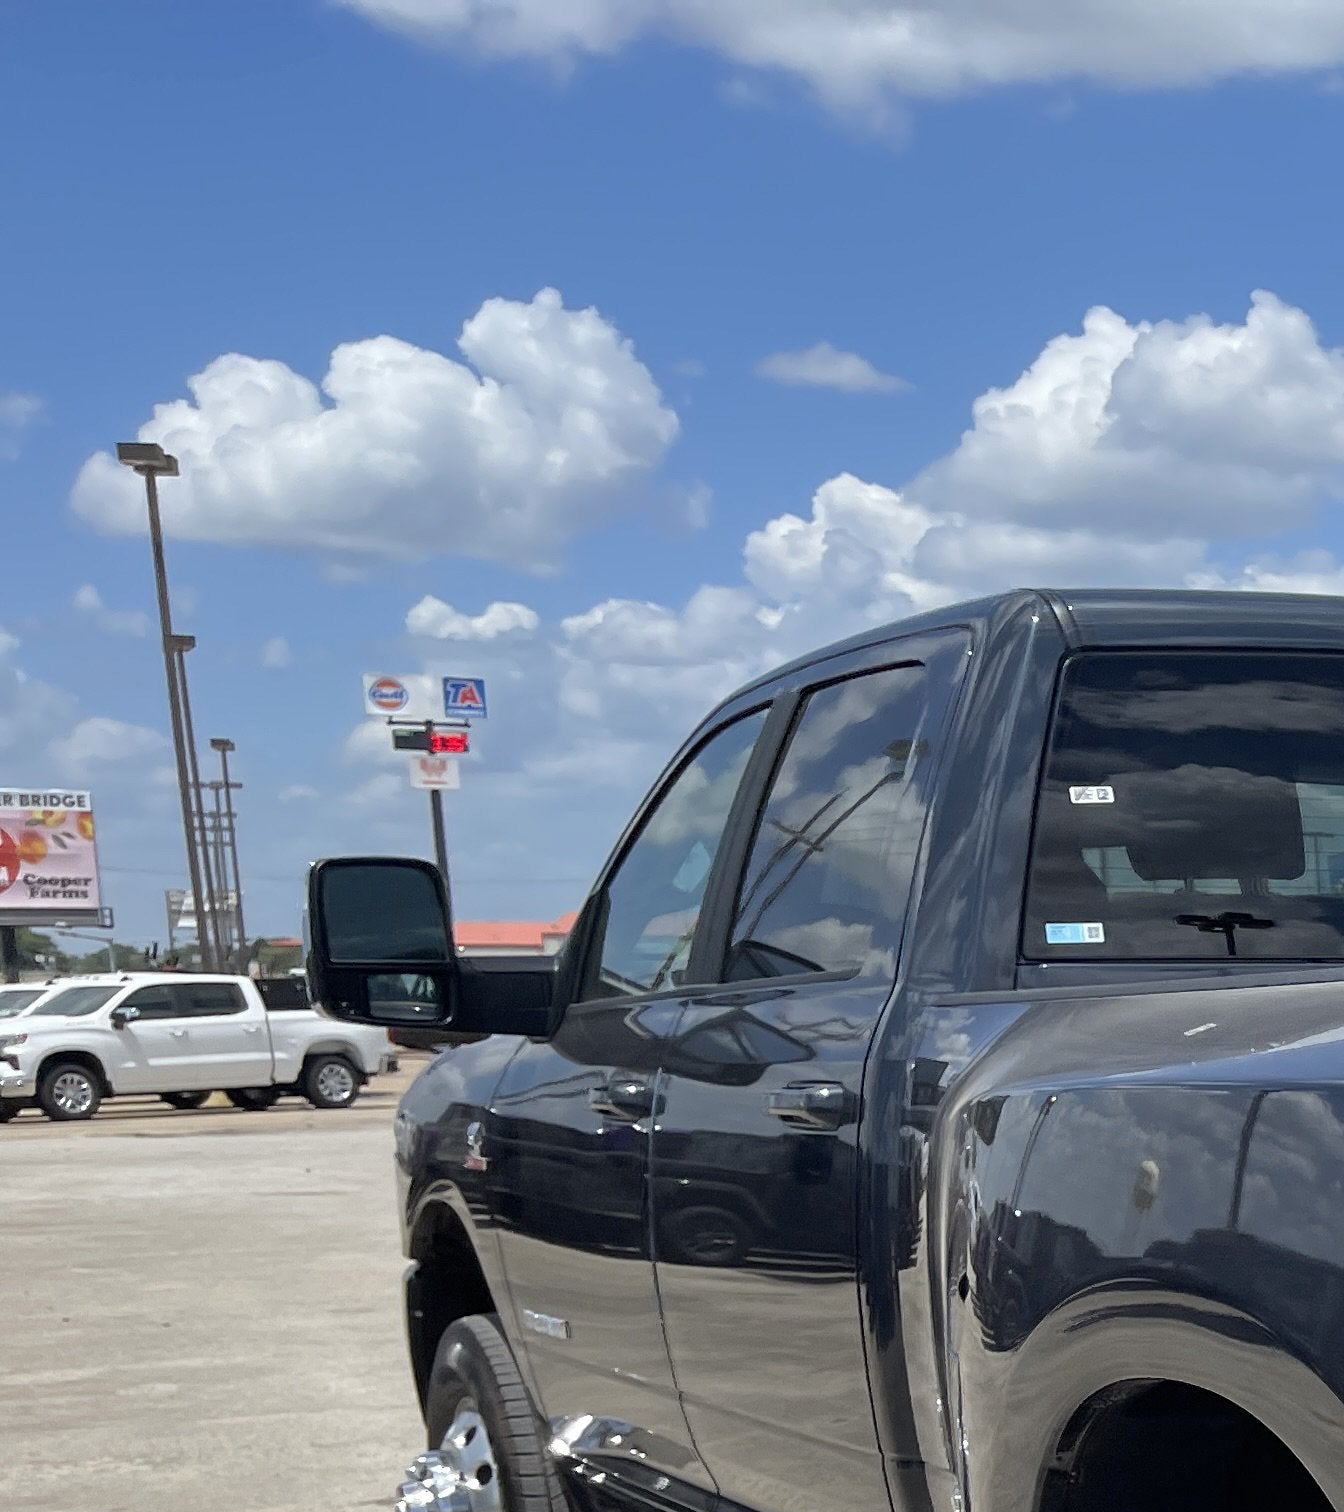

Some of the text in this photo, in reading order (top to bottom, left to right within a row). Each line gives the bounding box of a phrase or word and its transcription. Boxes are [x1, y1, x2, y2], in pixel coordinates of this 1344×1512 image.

[19, 794, 86, 808] BRIDGE
[23, 873, 92, 888] Cooper
[30, 886, 88, 899] Farms
